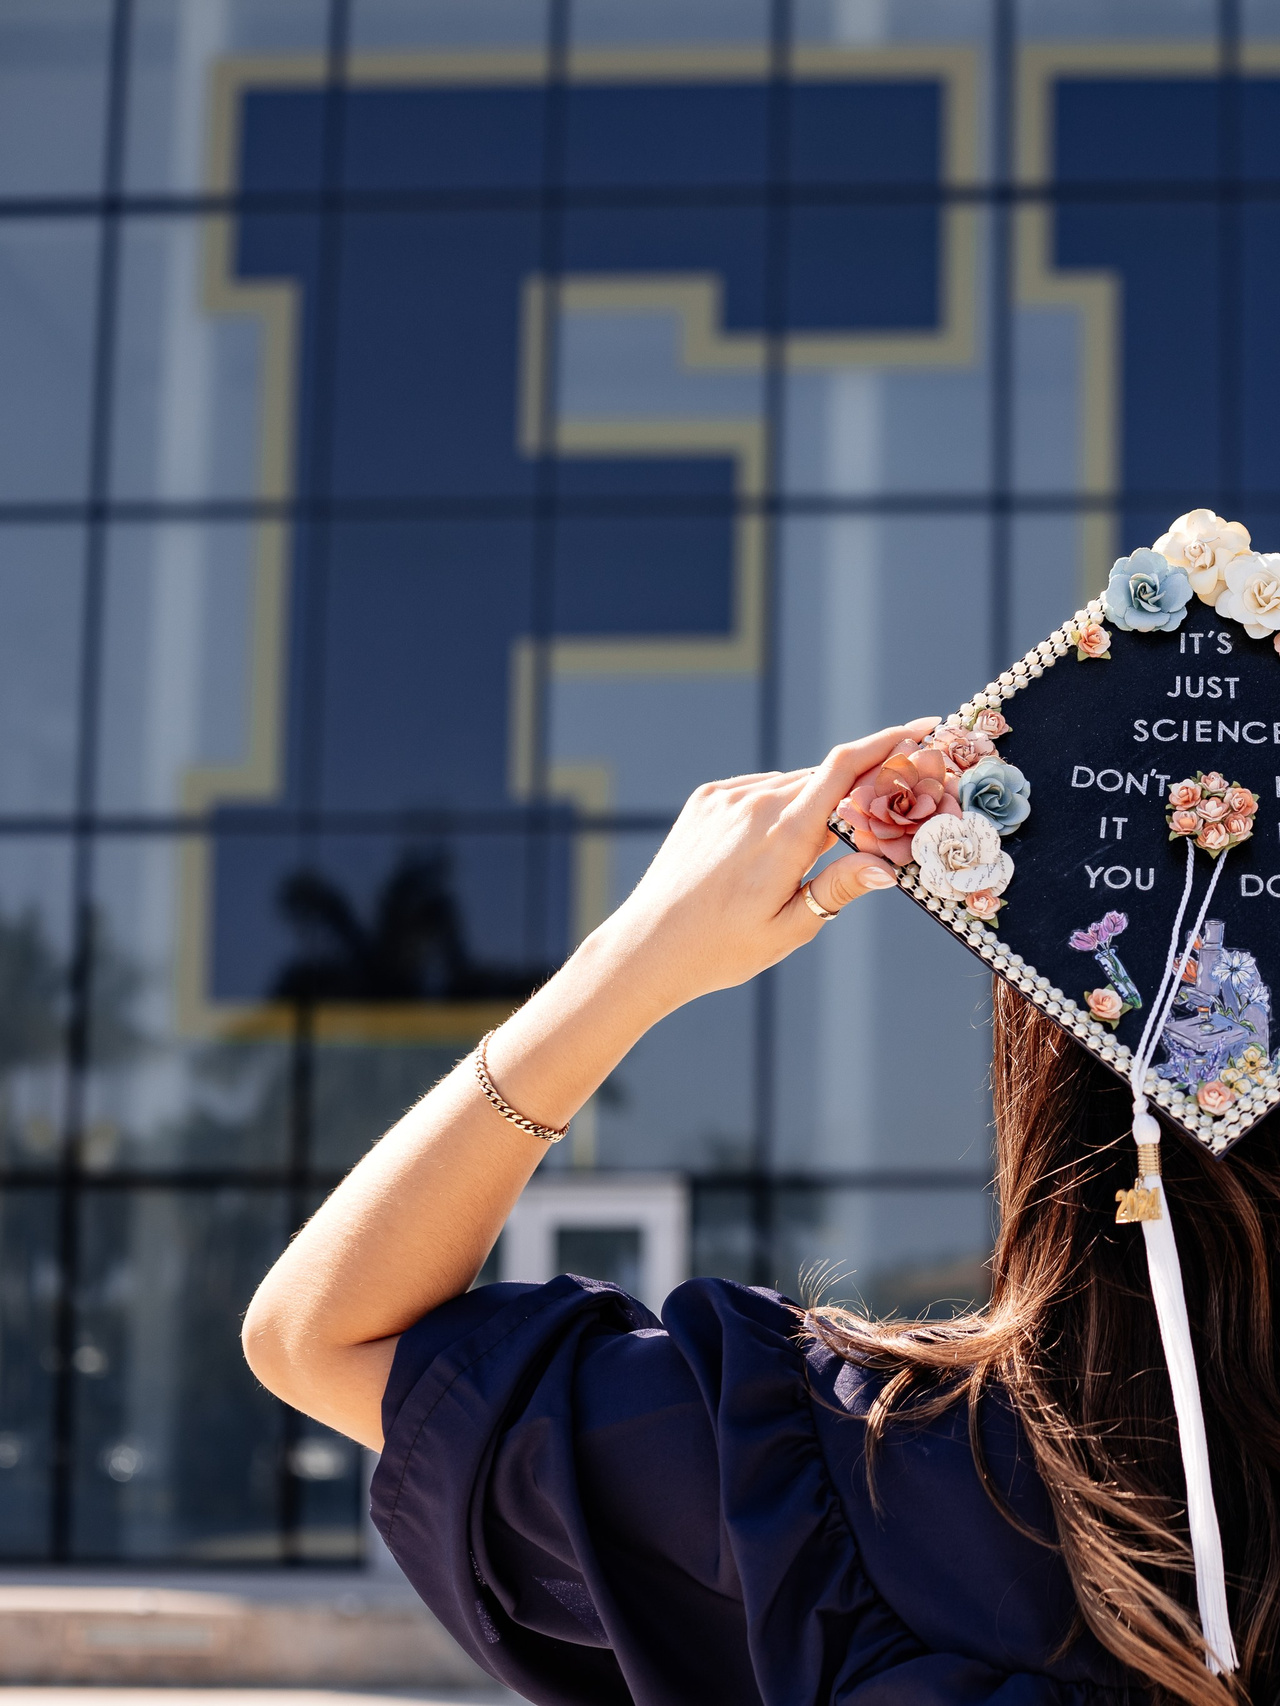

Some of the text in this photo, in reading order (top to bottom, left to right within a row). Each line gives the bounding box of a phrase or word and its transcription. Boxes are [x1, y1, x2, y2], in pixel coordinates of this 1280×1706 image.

[1180, 631, 1232, 654] IT'S
[1167, 676, 1239, 698] JUST
[1072, 766, 1170, 796] DON'T
[1100, 817, 1128, 839] IT
[1085, 865, 1154, 890] YOU
[1115, 1187, 1162, 1224] 2024
